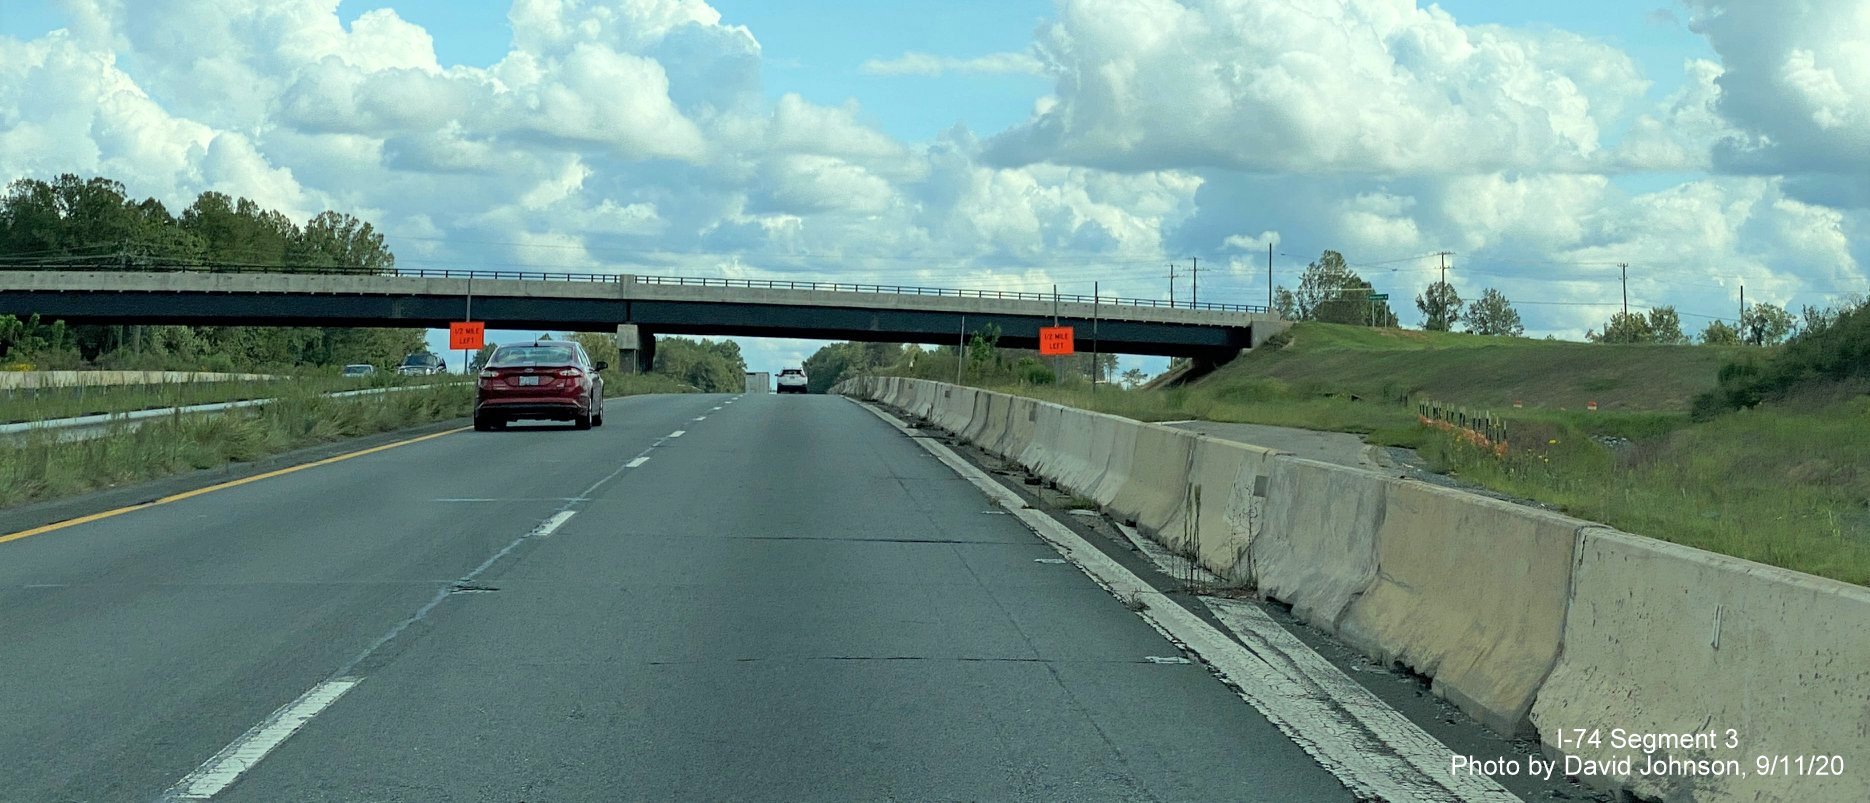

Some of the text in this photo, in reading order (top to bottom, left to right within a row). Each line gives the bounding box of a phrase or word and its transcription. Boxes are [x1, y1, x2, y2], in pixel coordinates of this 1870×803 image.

[465, 327, 480, 335] MILE
[1054, 332, 1068, 340] MILE
[459, 336, 474, 345] LEFT
[1049, 341, 1063, 350] LEFT
